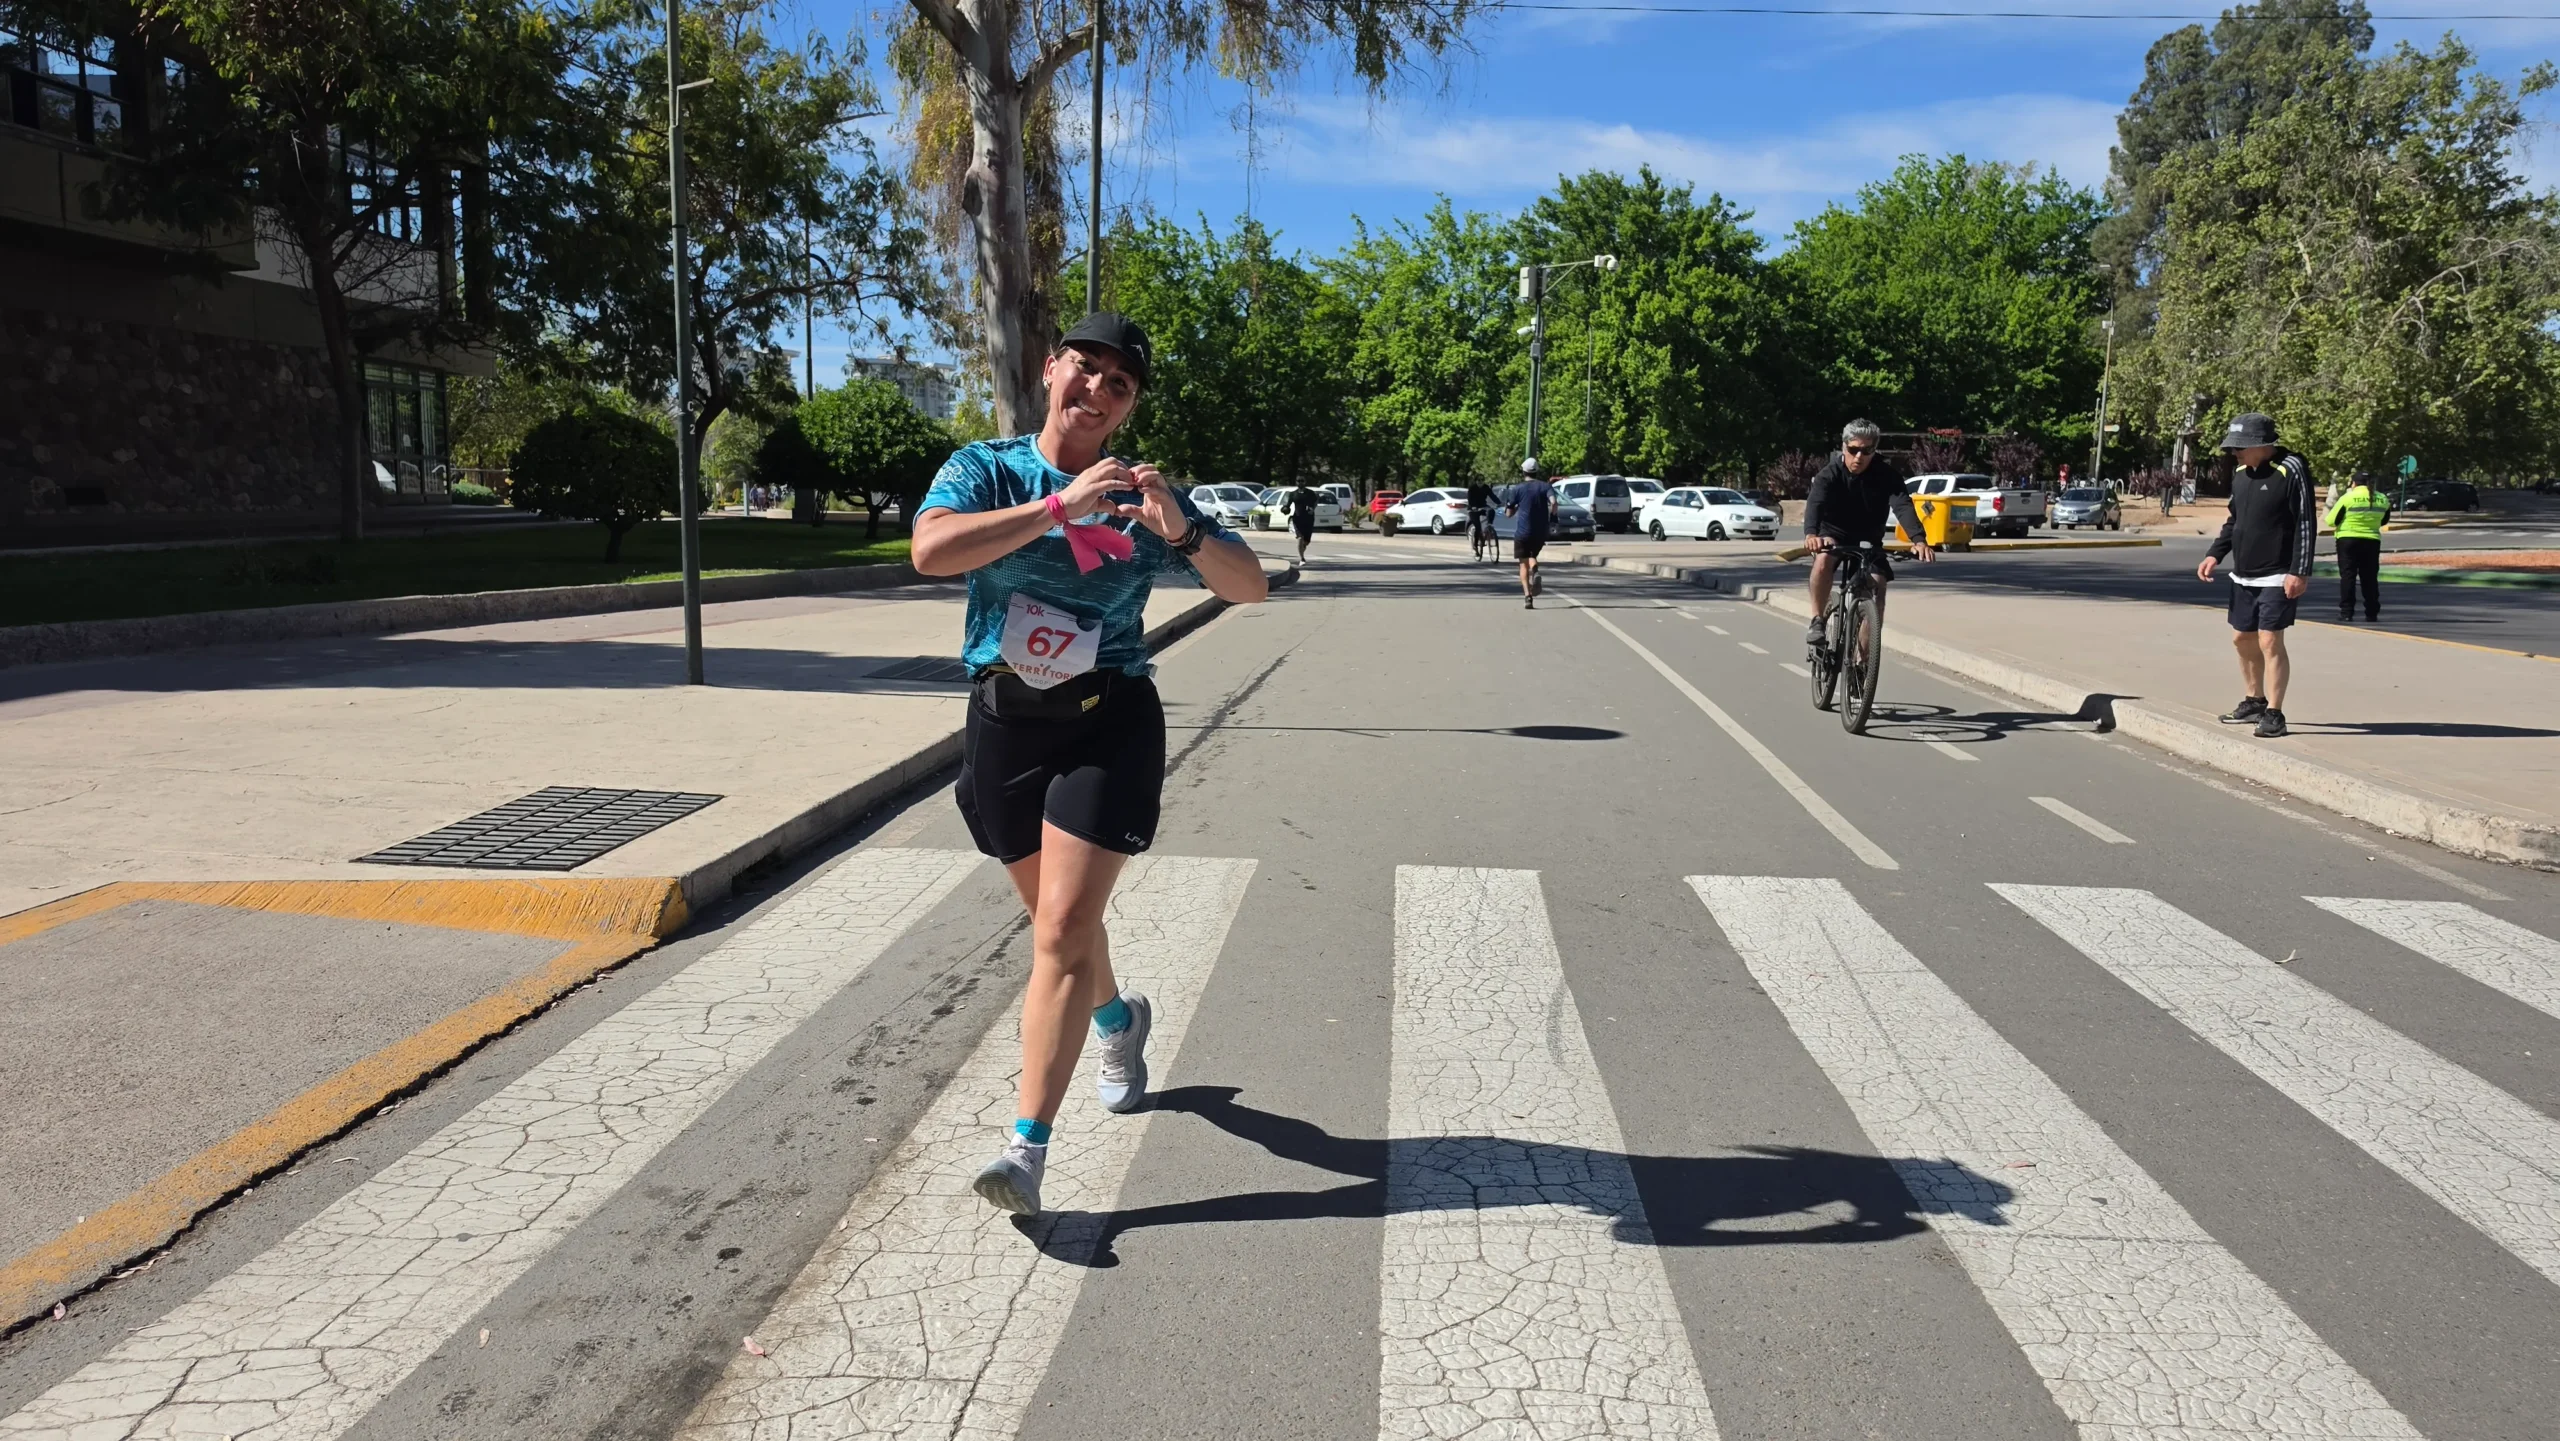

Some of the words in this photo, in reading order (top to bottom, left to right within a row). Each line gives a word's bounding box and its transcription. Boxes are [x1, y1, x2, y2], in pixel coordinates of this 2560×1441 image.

[689, 423, 696, 435] 2
[1025, 604, 1046, 617] 10k
[1027, 626, 1079, 660] 67
